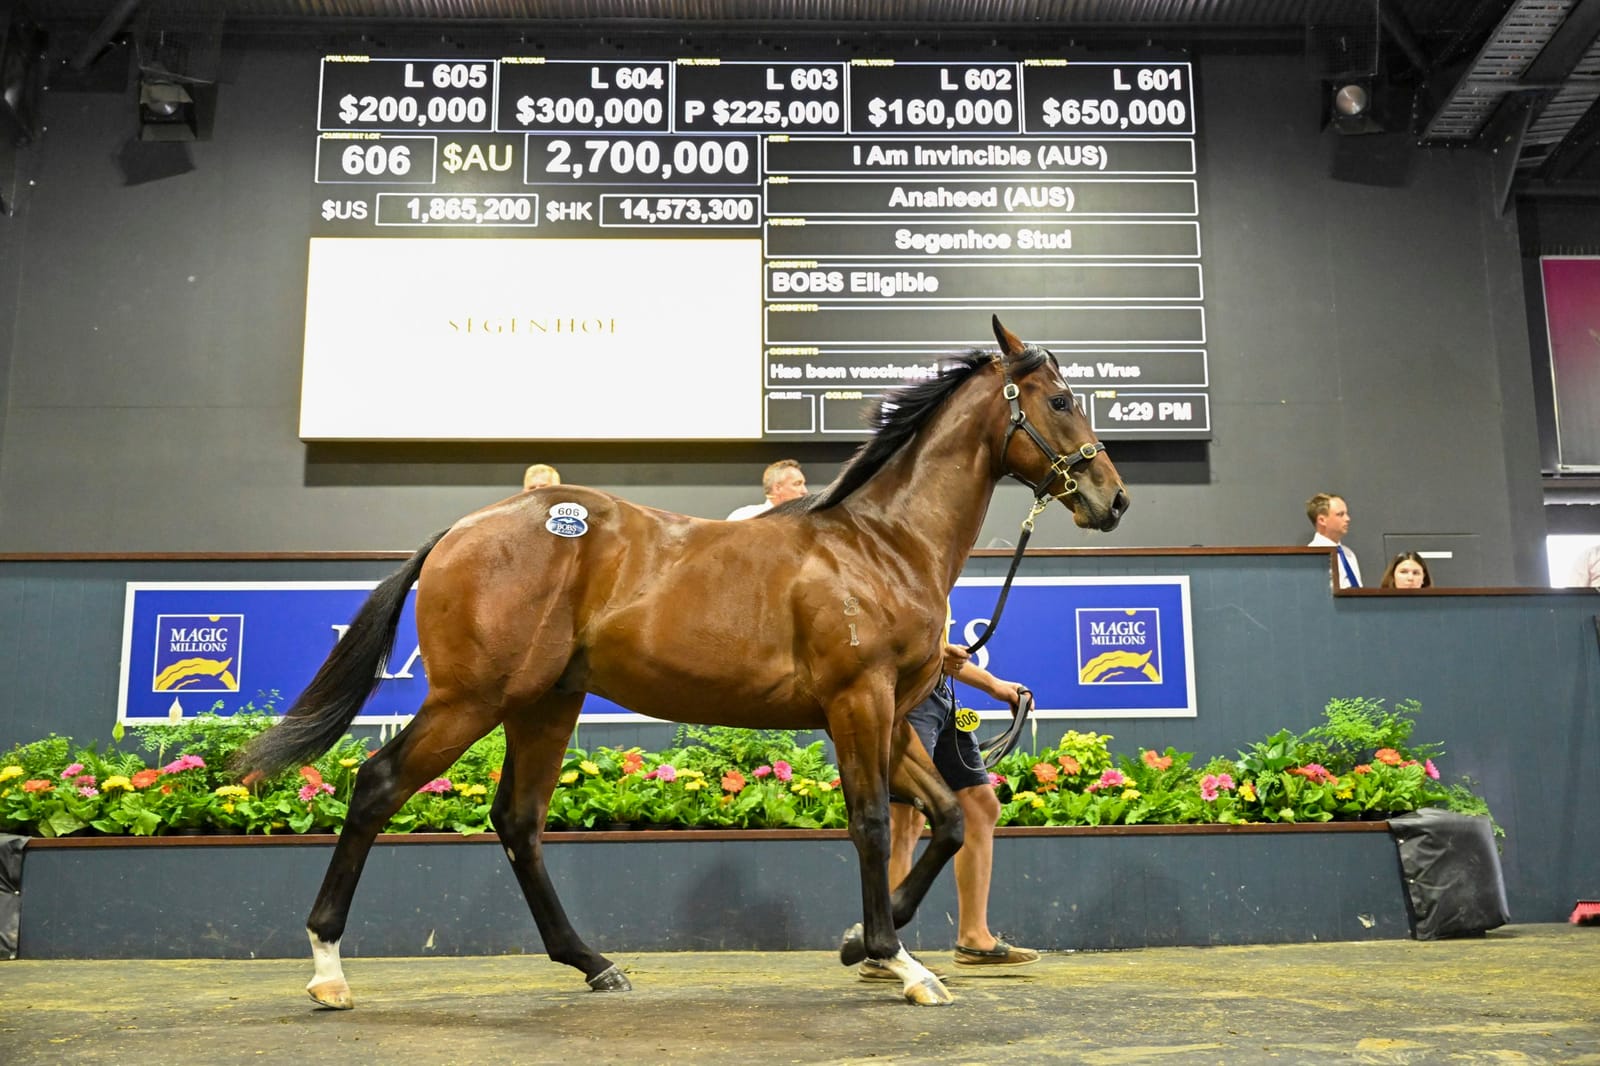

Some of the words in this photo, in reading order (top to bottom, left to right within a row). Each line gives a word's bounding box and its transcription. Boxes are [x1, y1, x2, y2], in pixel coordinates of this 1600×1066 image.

[405, 64, 424, 87] L
[433, 64, 486, 88] 605
[592, 67, 608, 88] L
[616, 68, 663, 89] 604
[766, 69, 784, 90] L
[791, 69, 838, 90] 603
[941, 69, 958, 90] L
[965, 69, 1011, 90] 602
[1114, 69, 1131, 90] L
[1138, 69, 1181, 90] 601
[339, 94, 486, 126] $200,000
[516, 96, 662, 127] $300,000
[685, 101, 705, 123] P
[713, 99, 839, 127] $225,000
[869, 98, 1012, 129] $160,000
[1043, 98, 1185, 129] $650,000
[342, 145, 411, 175] 606
[443, 143, 512, 174] $AU
[546, 140, 748, 179] 2,700,000
[854, 146, 860, 165] I
[866, 146, 908, 165] Am
[915, 145, 1031, 166] Invincible
[1037, 145, 1107, 170] (AUS)
[322, 199, 367, 221] $US
[406, 198, 531, 223] 1,865,200
[546, 200, 592, 222] $HK
[620, 199, 753, 223] 14,573,300
[889, 187, 998, 207] Anaheed
[1004, 187, 1075, 212] (AUS)
[895, 230, 1012, 253] Segenhoe
[1017, 230, 1072, 250] Stud
[773, 272, 844, 292] BOBS
[851, 272, 939, 297] Eligible
[771, 364, 802, 378] Has
[806, 363, 846, 378] been
[849, 363, 939, 379] vaccinated
[1096, 363, 1141, 377] Virus
[1108, 402, 1153, 421] 4:29
[1159, 402, 1192, 420] PM
[557, 507, 580, 517] 606
[170, 628, 228, 642] MAGIC
[1090, 621, 1145, 635] MAGIC
[170, 643, 227, 652] MILLIONS
[1091, 636, 1146, 645] MILLIONS
[955, 711, 978, 728] 606
